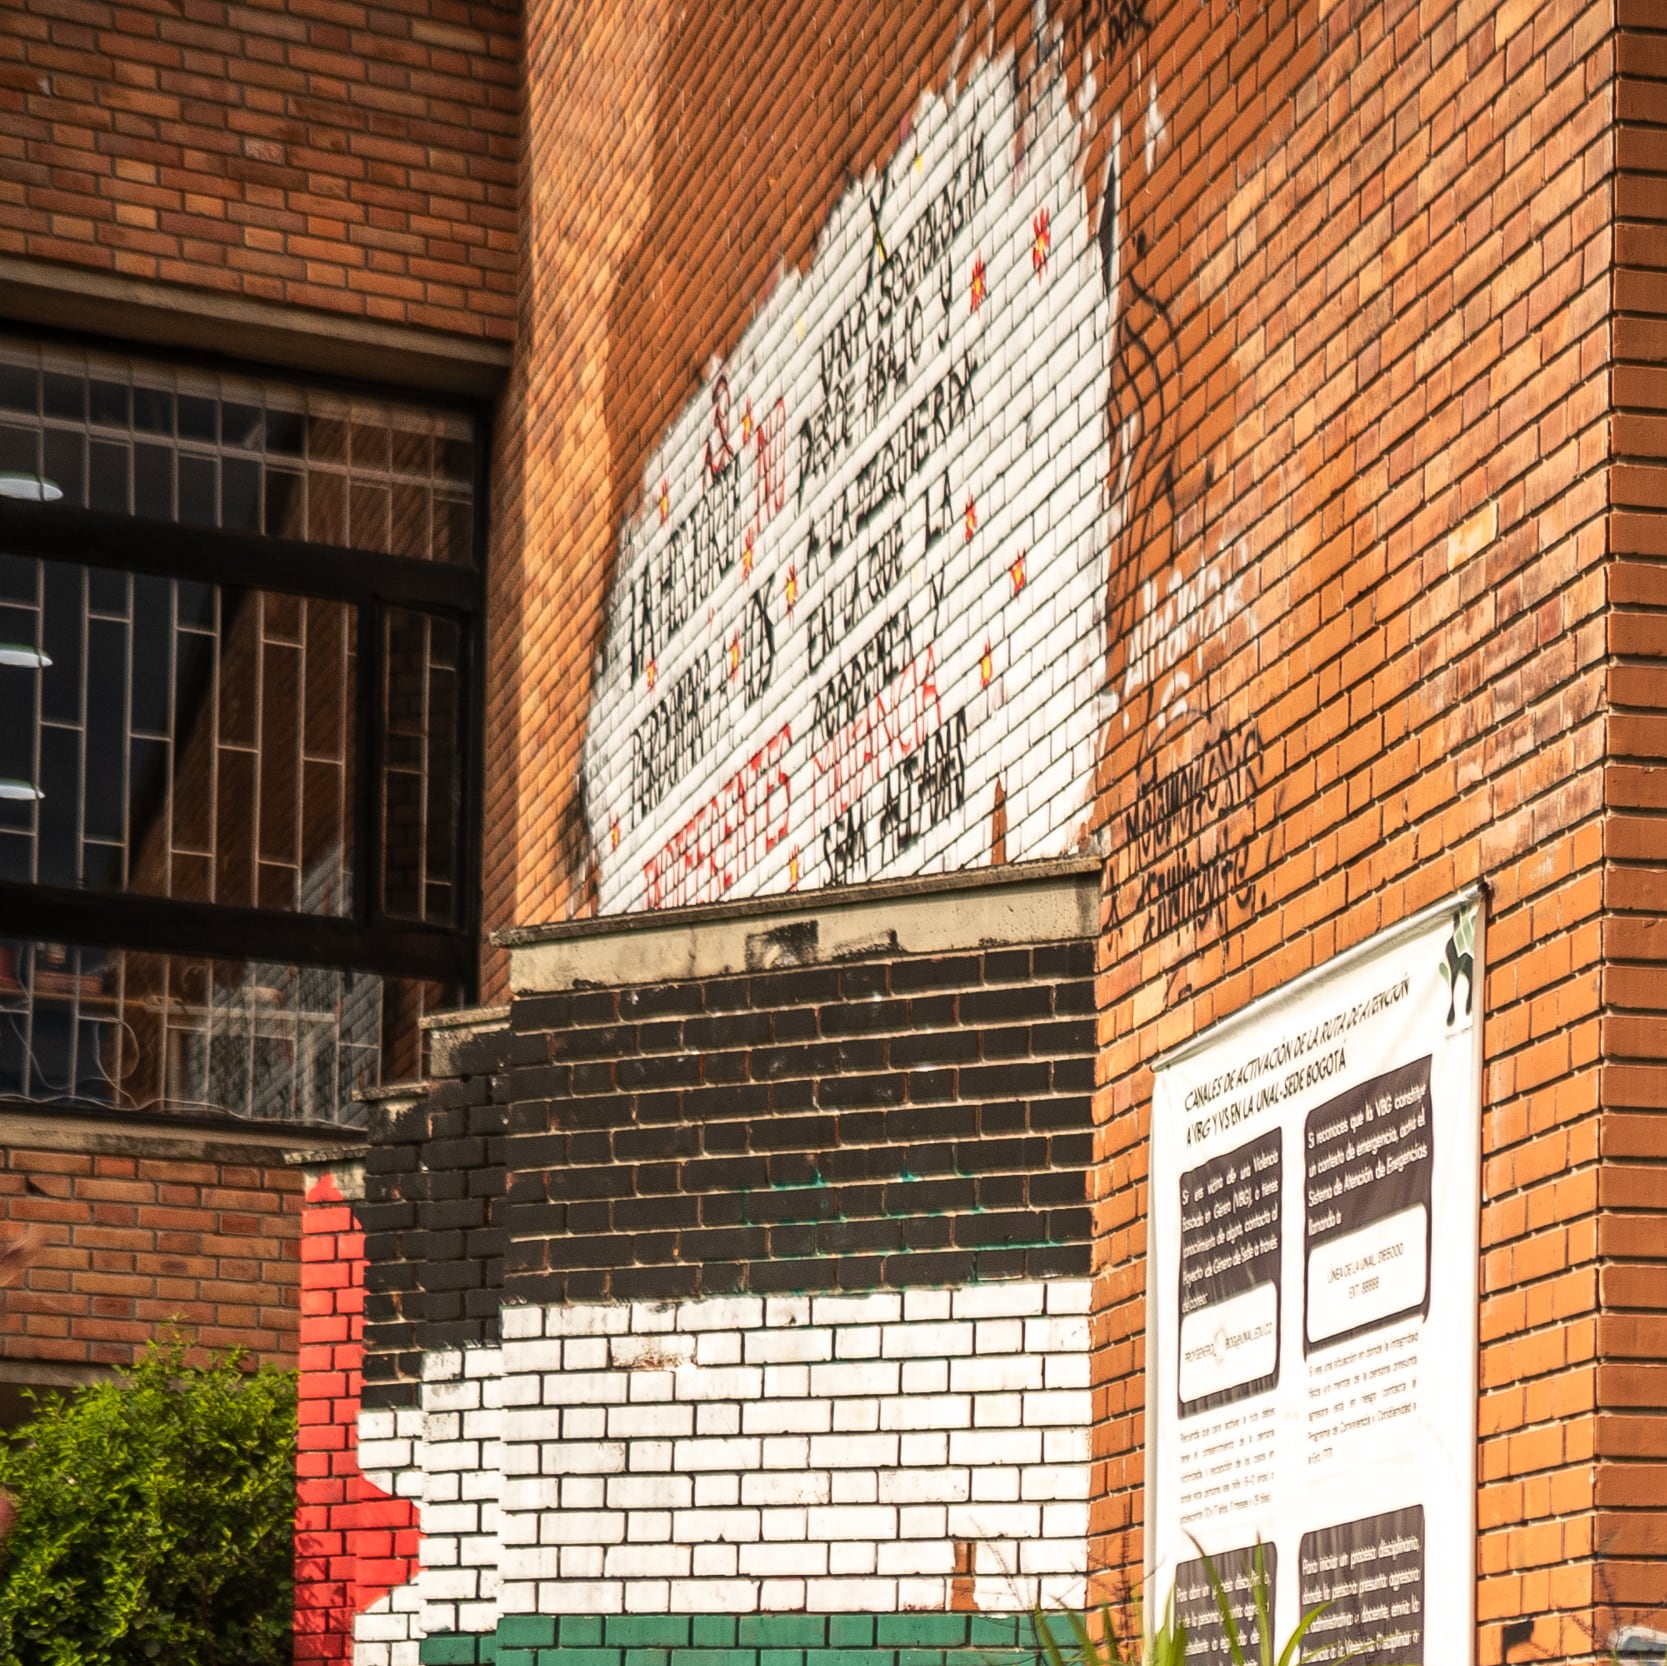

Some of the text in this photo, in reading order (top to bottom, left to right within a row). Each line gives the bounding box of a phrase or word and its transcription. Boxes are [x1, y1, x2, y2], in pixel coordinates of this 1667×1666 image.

[1185, 1076, 1221, 1113] CANALES
[1224, 1070, 1234, 1093] DE
[1236, 1038, 1292, 1087] ACTIVACIÓN
[1294, 1033, 1304, 1058] DE
[1306, 1027, 1317, 1051] LA
[1320, 1012, 1345, 1045] RUTA
[1231, 1100, 1241, 1125] EN
[1243, 1094, 1253, 1119] LA
[1307, 1043, 1346, 1085] BOGOTÁ
